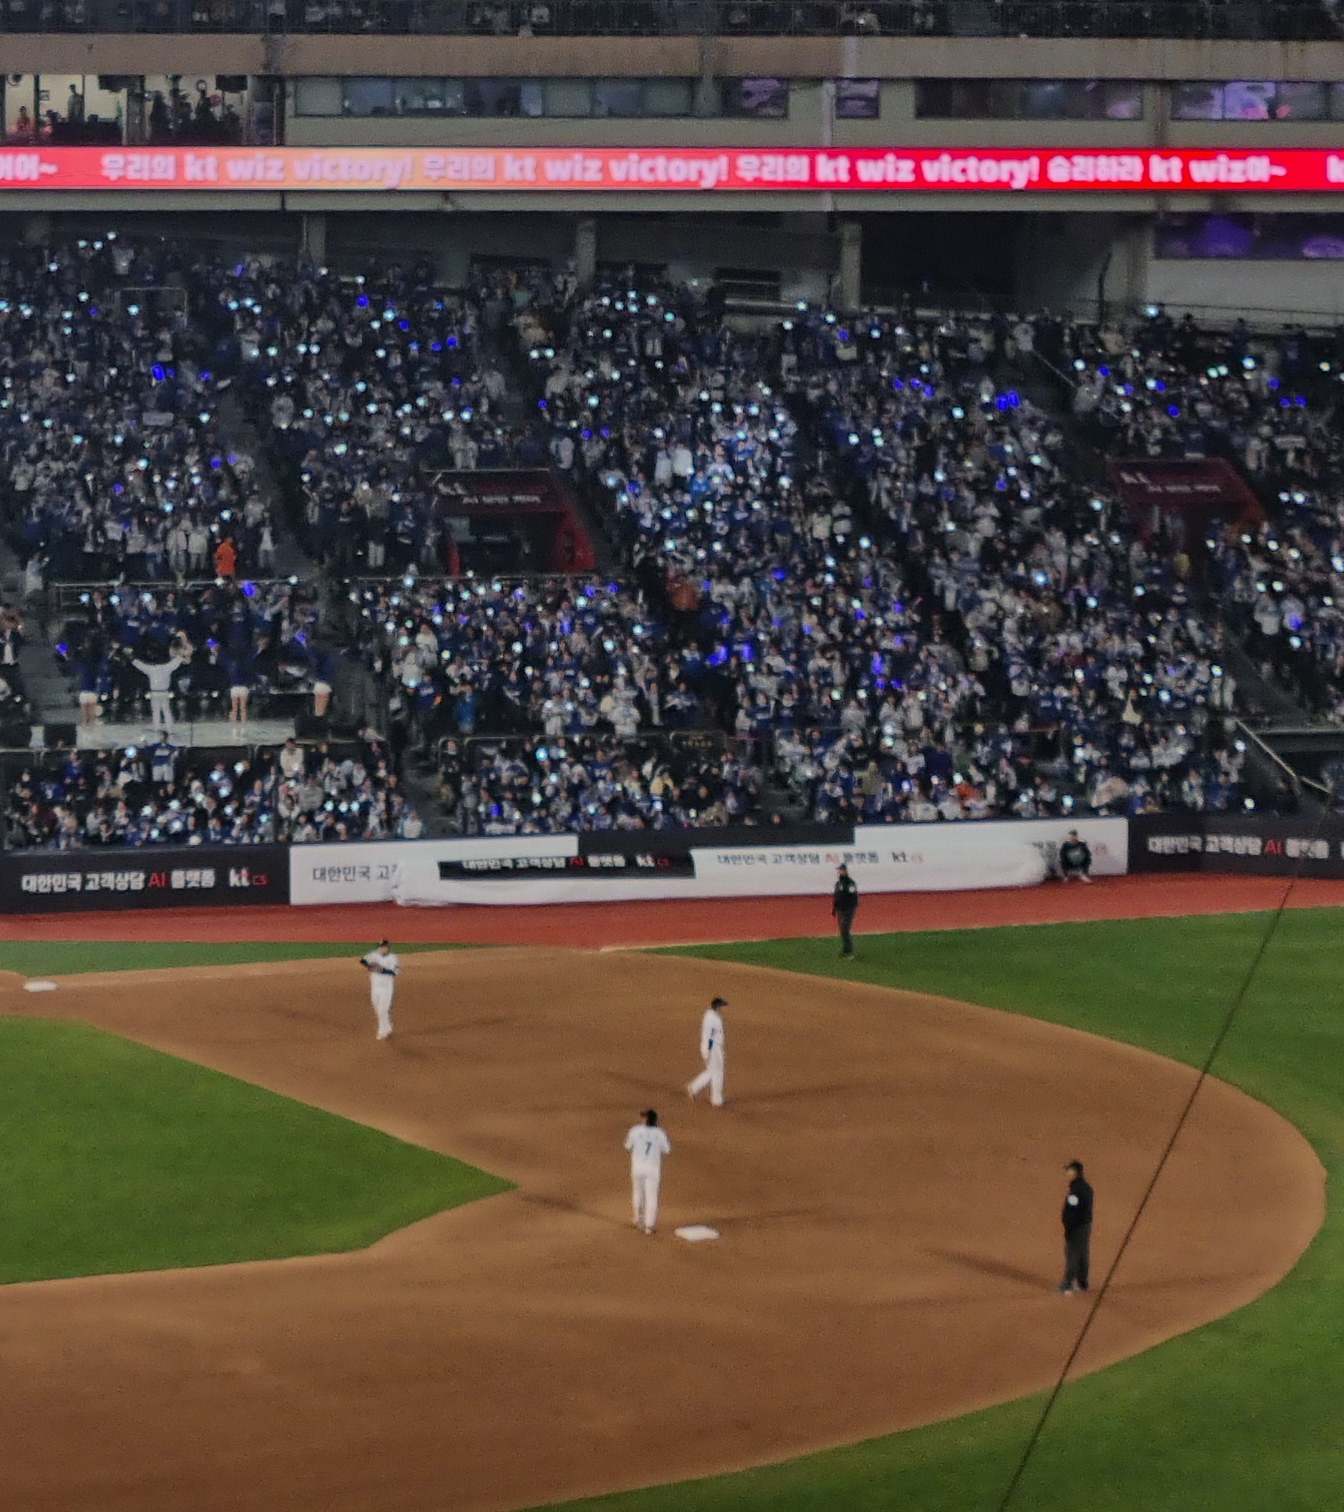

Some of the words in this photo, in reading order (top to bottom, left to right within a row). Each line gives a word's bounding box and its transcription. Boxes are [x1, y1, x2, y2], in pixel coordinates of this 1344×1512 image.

[101, 152, 175, 181] 우리의
[184, 152, 219, 181] kt
[226, 152, 285, 181] wiz
[294, 153, 413, 189] victory!
[423, 153, 496, 181] 우리의
[503, 153, 536, 181] kt
[544, 153, 604, 181] wiz
[608, 153, 729, 189] victory!
[735, 154, 810, 182] 우리의
[815, 153, 851, 182] kt
[856, 153, 916, 182] wiz
[920, 153, 1040, 190] victory!
[1148, 154, 1183, 183] kt
[21, 872, 82, 893] 대한민국
[84, 871, 145, 891] 고객상담
[148, 872, 168, 889] AI
[228, 867, 251, 889] kt
[312, 865, 370, 883] 대한민국
[645, 1141, 653, 1156] 7
